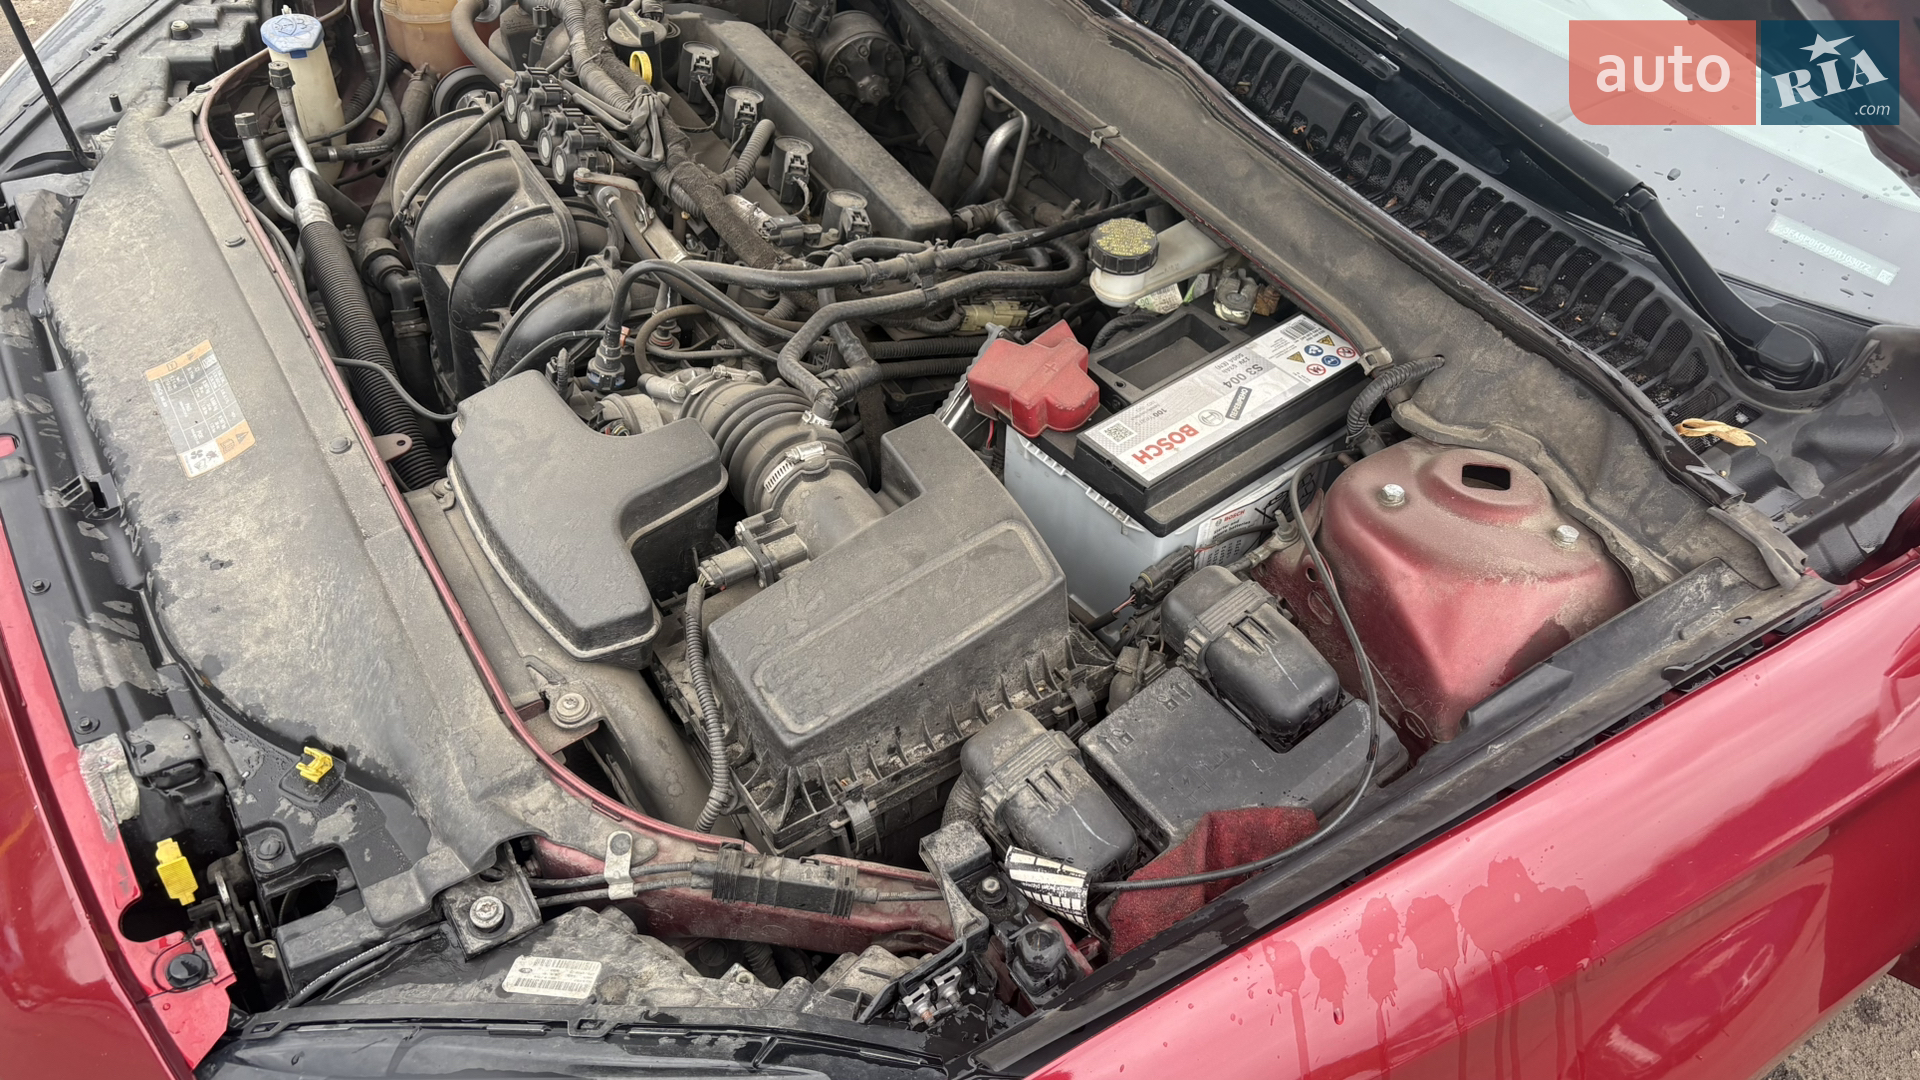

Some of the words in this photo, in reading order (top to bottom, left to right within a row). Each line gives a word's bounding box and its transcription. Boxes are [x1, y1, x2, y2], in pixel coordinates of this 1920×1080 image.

[1245, 363, 1263, 376] S3
[1222, 373, 1247, 389] 004
[1151, 407, 1167, 417] 100
[1132, 423, 1199, 465] BOSCH
[1224, 510, 1245, 521] BOSCH
[1229, 519, 1250, 530] batteries
